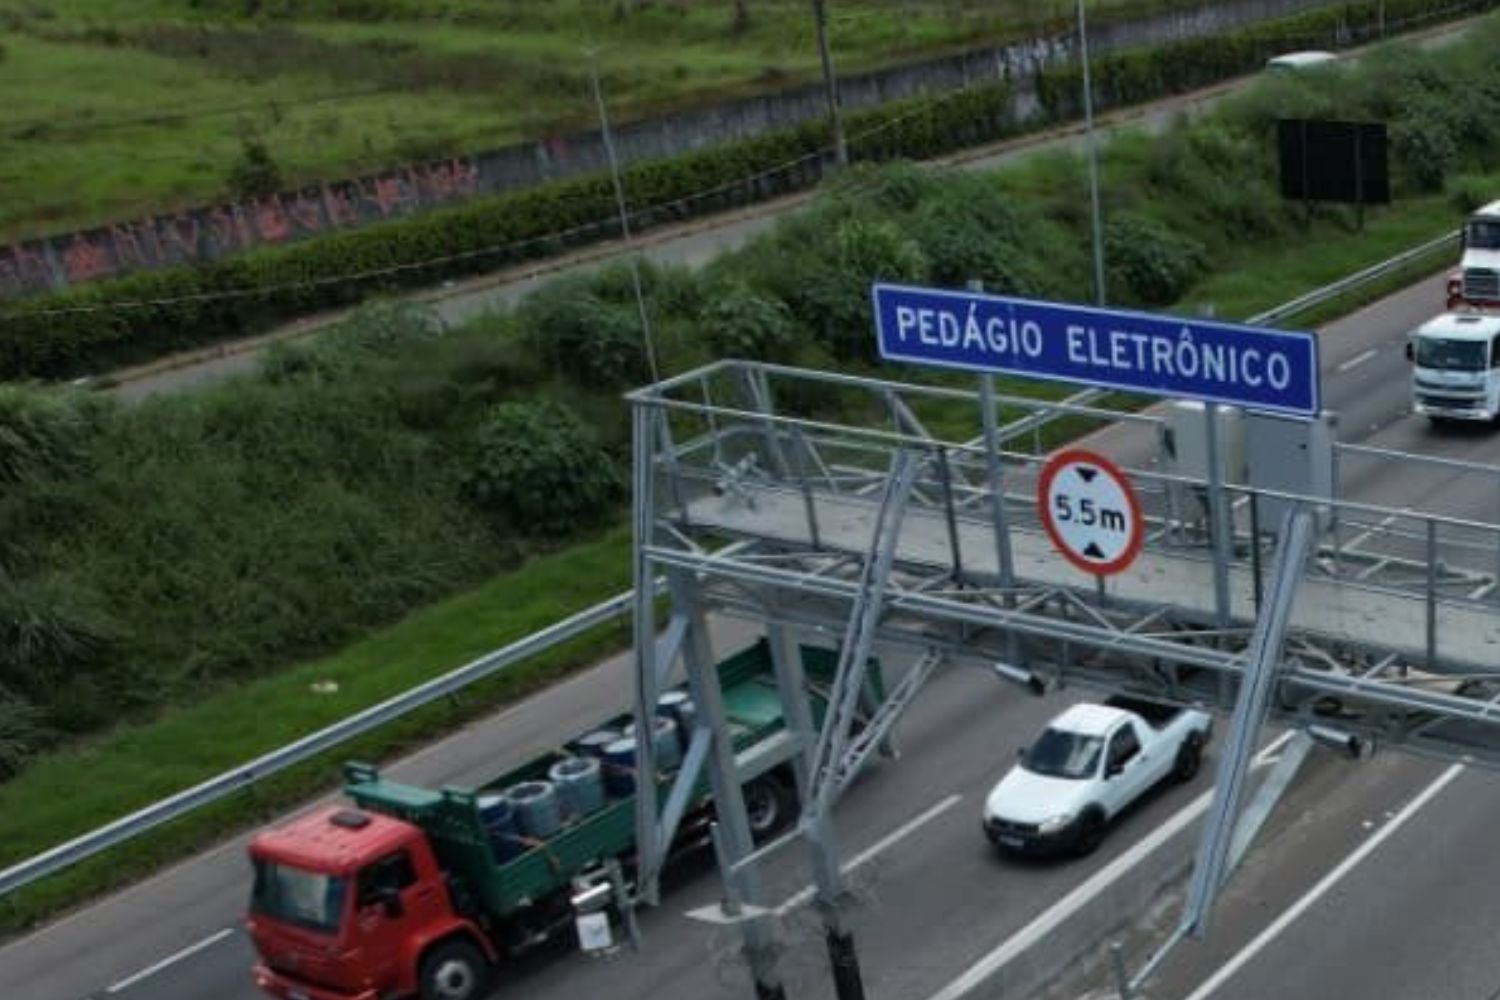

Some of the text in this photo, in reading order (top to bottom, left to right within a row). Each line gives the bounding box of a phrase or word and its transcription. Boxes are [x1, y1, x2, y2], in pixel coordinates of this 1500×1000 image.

[896, 303, 1291, 390] PEDÁGIO ELETRÔNICO
[1054, 493, 1126, 534] 5.5m
